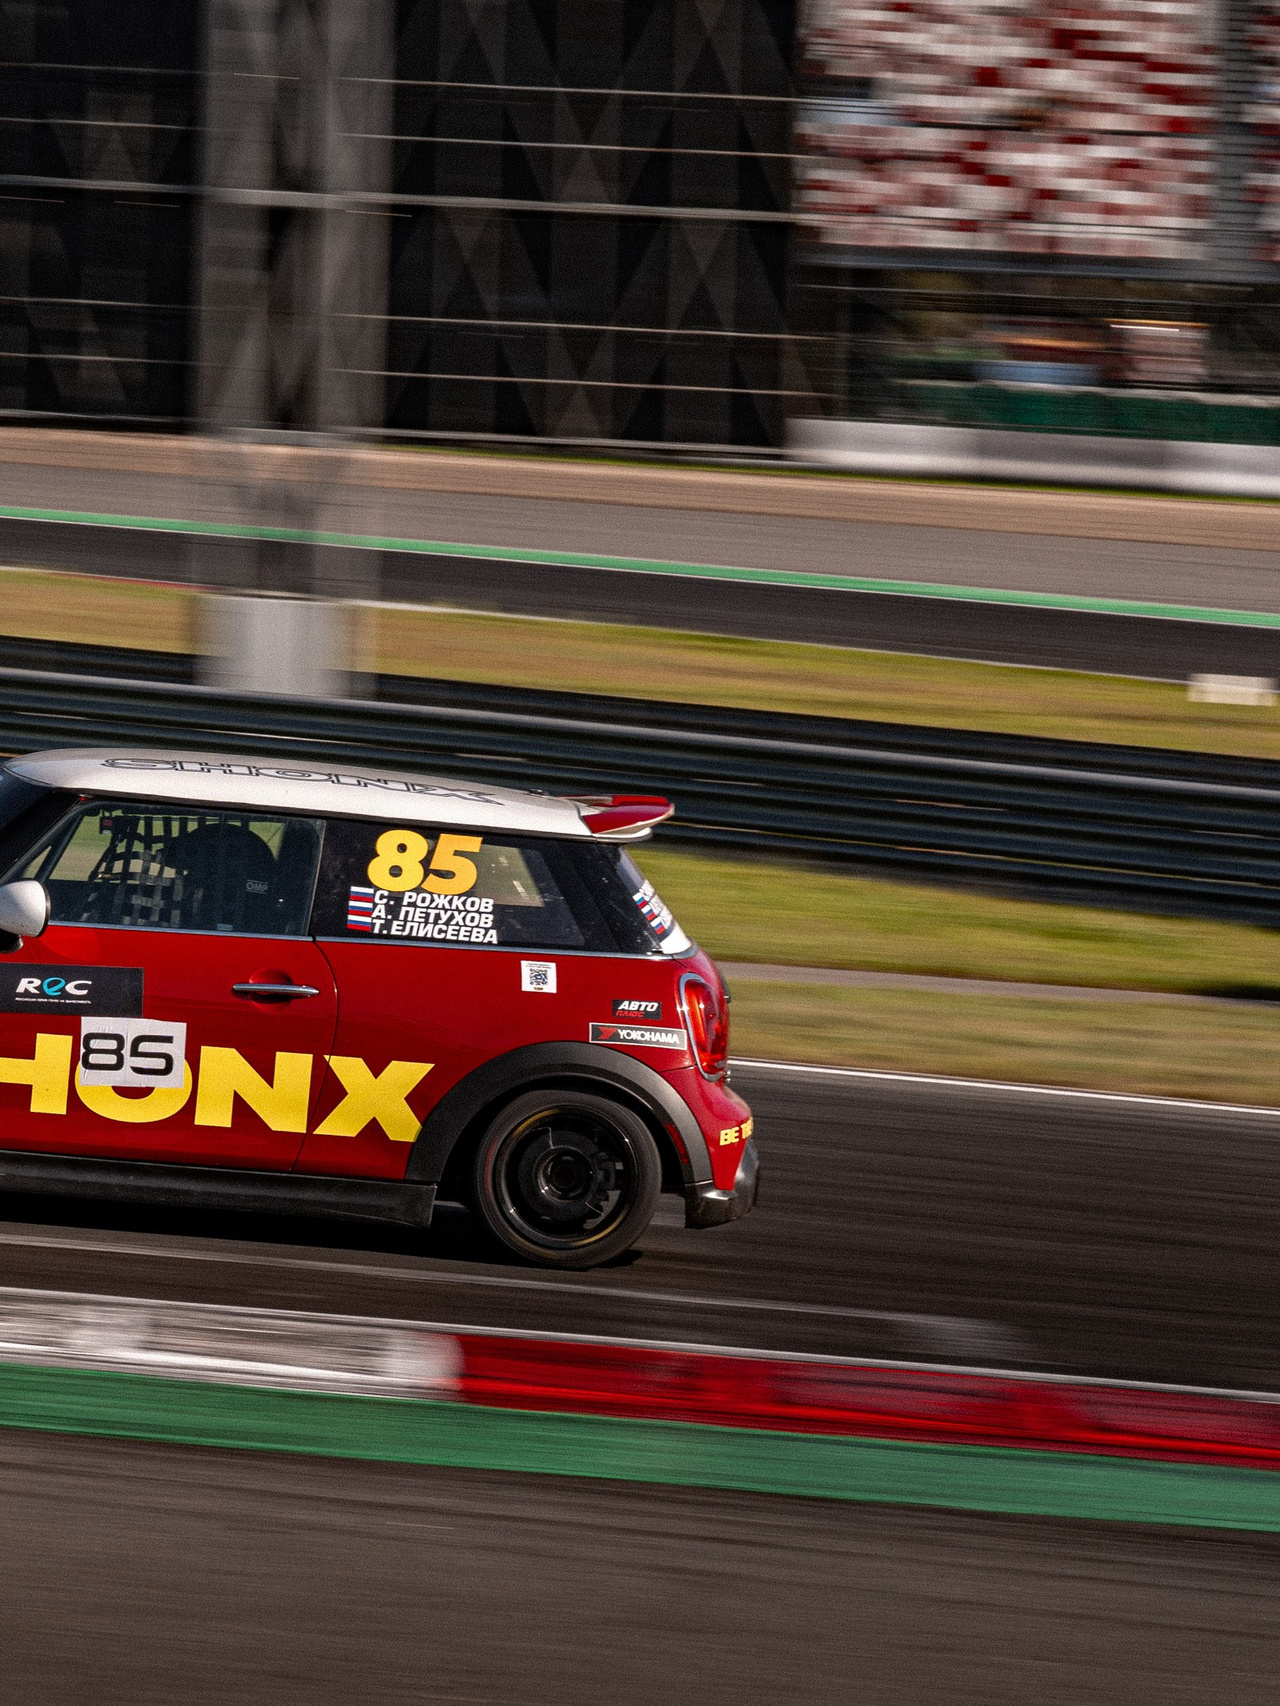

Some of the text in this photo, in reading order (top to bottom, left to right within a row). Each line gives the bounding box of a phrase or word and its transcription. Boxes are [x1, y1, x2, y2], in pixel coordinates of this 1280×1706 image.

[100, 758, 505, 806] SHONX
[367, 829, 483, 895] 85
[373, 889, 495, 913] С. РОЖКОВ
[371, 904, 494, 928] А. ПЕТУХОВ
[617, 1000, 659, 1012] АВТО
[617, 1028, 680, 1045] YOKOHAMA
[81, 1032, 174, 1077] 85
[720, 1126, 740, 1146] BE
